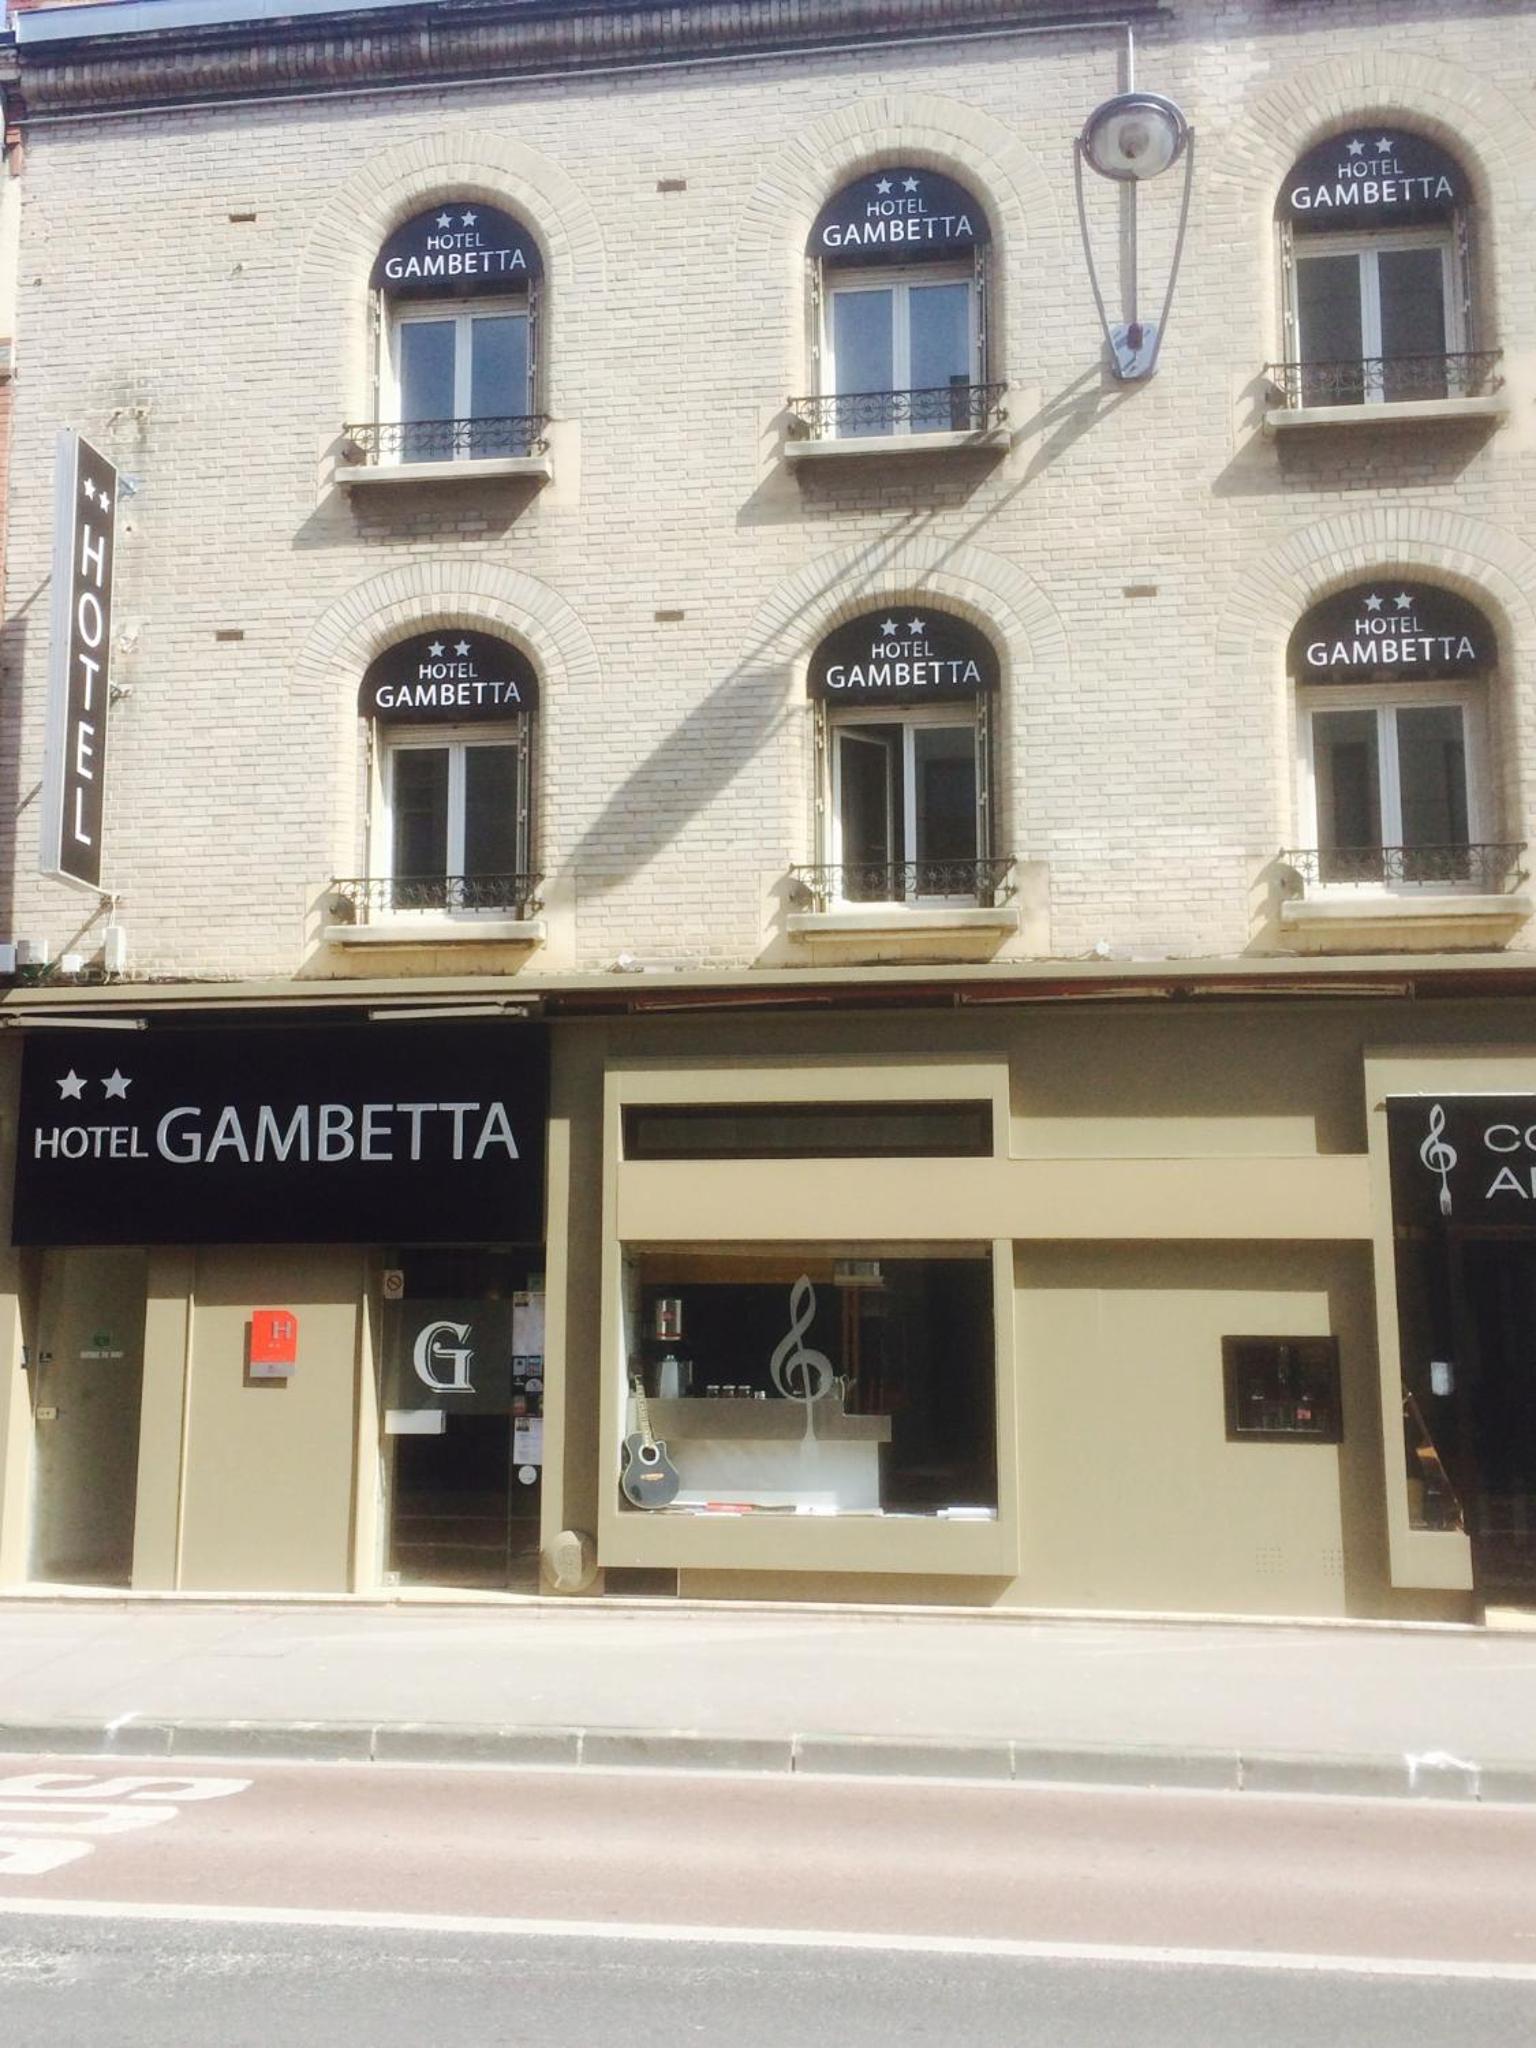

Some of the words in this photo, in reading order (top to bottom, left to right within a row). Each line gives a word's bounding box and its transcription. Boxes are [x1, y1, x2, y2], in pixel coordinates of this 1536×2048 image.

[1338, 158, 1404, 179] HOTEL
[1291, 176, 1453, 209] GAMBETTA
[866, 198, 928, 217] HOTEL
[427, 232, 486, 251] HOTEL
[822, 215, 973, 246] GAMBETTA
[385, 249, 526, 279] GAMBETTA
[1355, 616, 1424, 635] HOTEL
[871, 640, 934, 659] HOTEL
[1307, 636, 1475, 666] GAMBETTA
[74, 524, 105, 846] HOTEL
[419, 662, 478, 680] HOTEL
[826, 660, 981, 688] GAMBETTA
[375, 681, 521, 708] GAMBETTA
[34, 1125, 149, 1159] HOTEL
[156, 1101, 520, 1163] GAMBETTA
[1485, 1165, 1536, 1199] A
[272, 1320, 292, 1340] H
[413, 1320, 477, 1394] G
